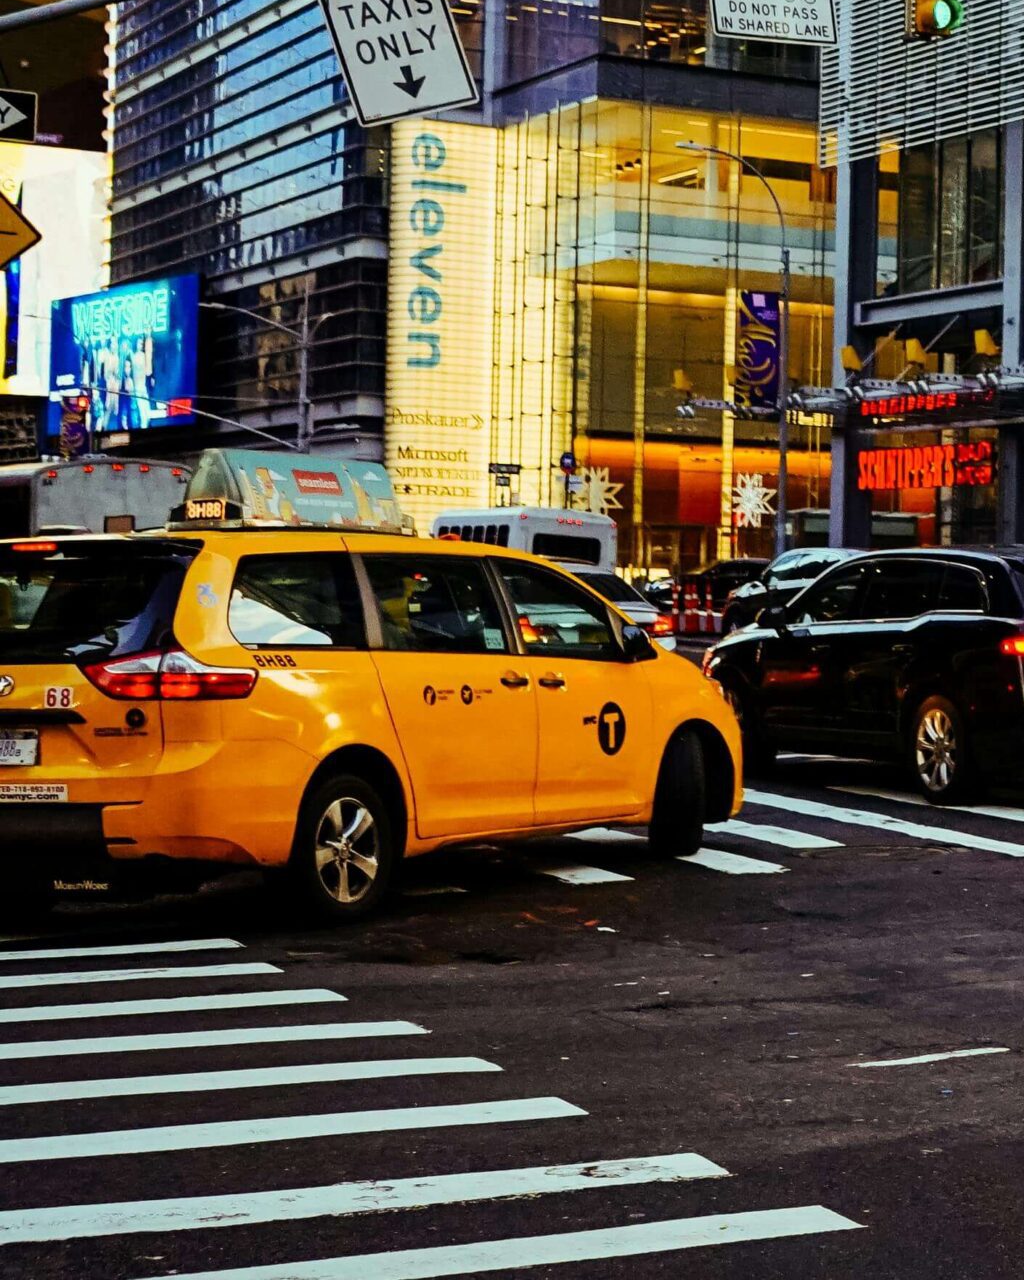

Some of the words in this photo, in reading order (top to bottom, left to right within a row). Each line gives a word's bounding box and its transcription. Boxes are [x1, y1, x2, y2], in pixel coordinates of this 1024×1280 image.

[729, 0, 747, 14] DO
[752, 3, 777, 17] NOT
[783, 7, 818, 20] PASS
[721, 16, 733, 29] IN
[739, 18, 790, 34] SHARED
[795, 24, 830, 38] LANE
[356, 24, 436, 65] ONLY
[407, 133, 467, 368] eleven
[391, 408, 469, 429] Proskauer
[397, 446, 468, 462] Microsoft
[187, 502, 221, 519] 8H88
[252, 655, 297, 667] 8H88
